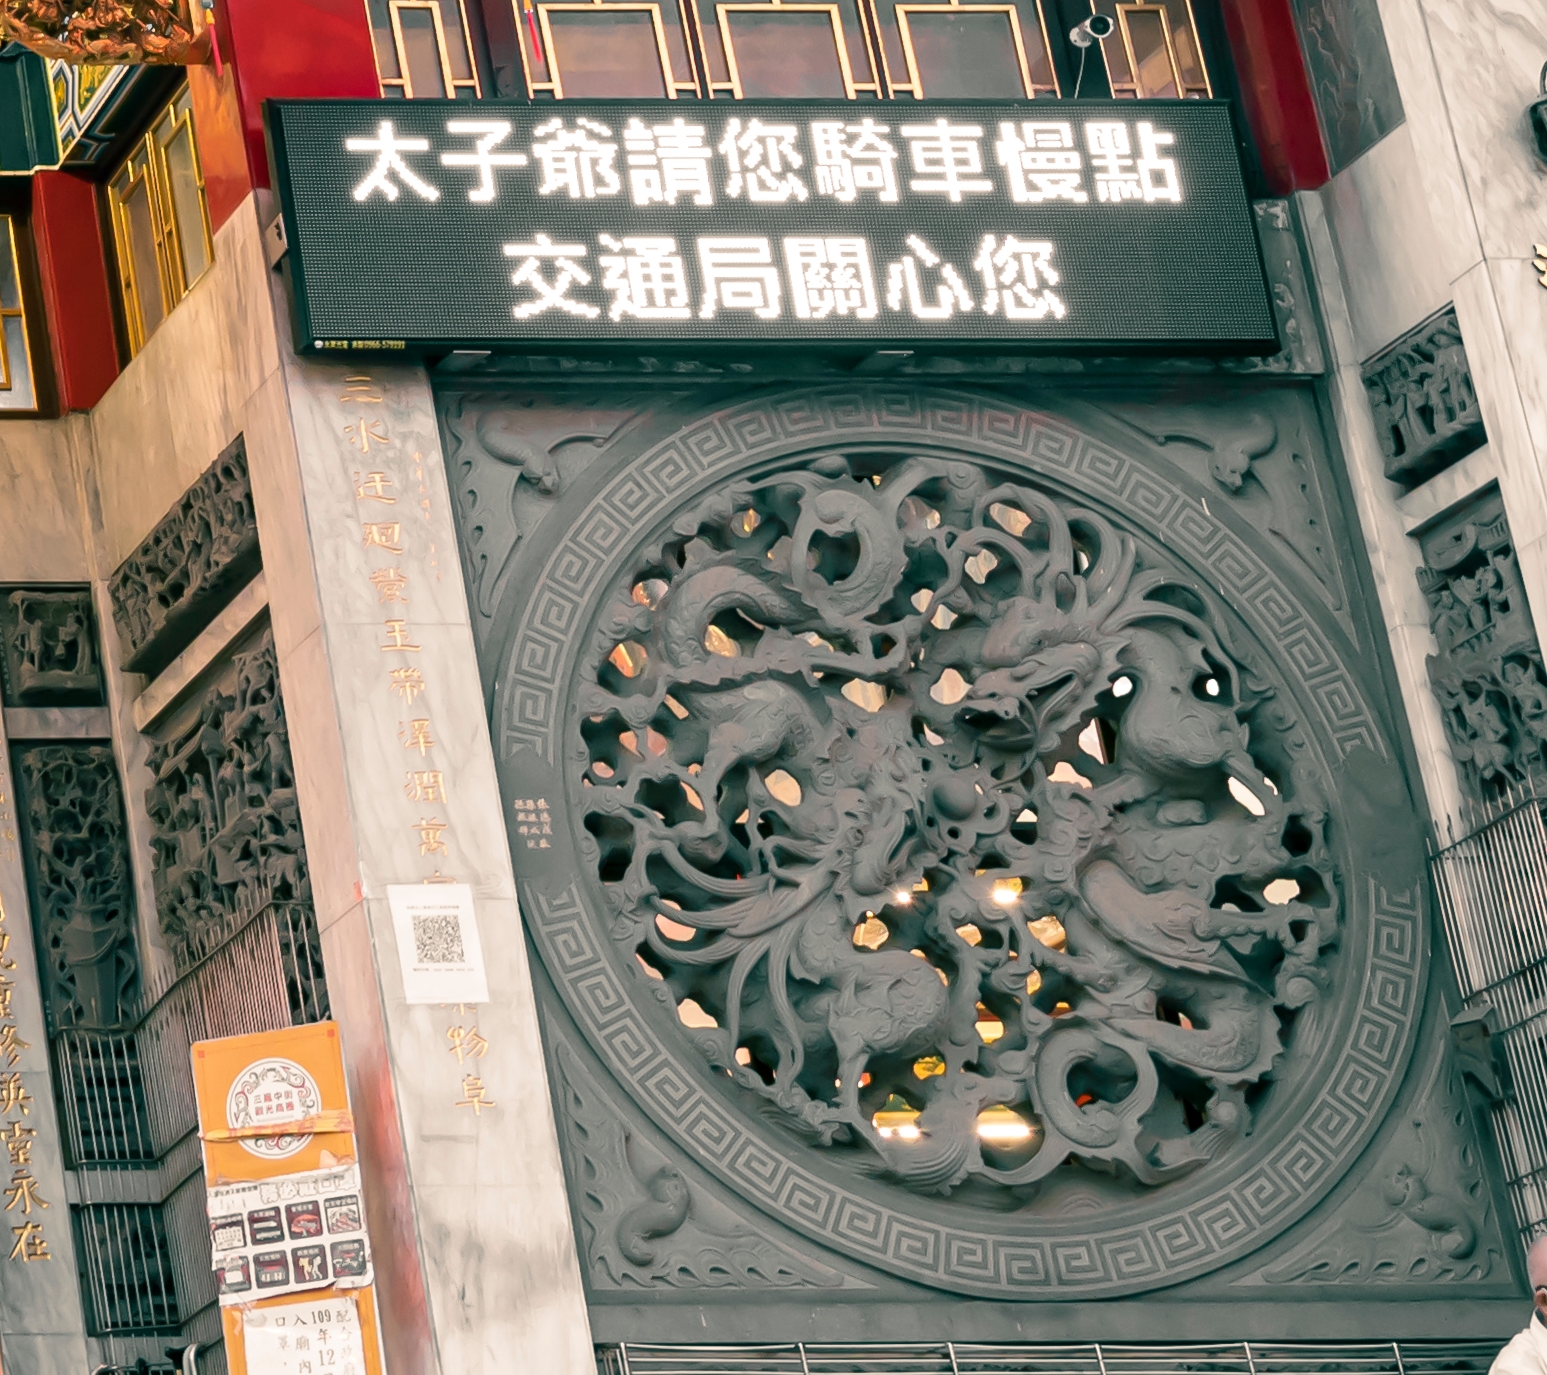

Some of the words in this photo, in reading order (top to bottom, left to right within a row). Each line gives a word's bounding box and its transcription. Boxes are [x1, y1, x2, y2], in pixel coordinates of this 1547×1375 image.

[346, 118, 1183, 206] 太子爺請您騎車慢點
[504, 232, 1068, 322] 交通局關心您
